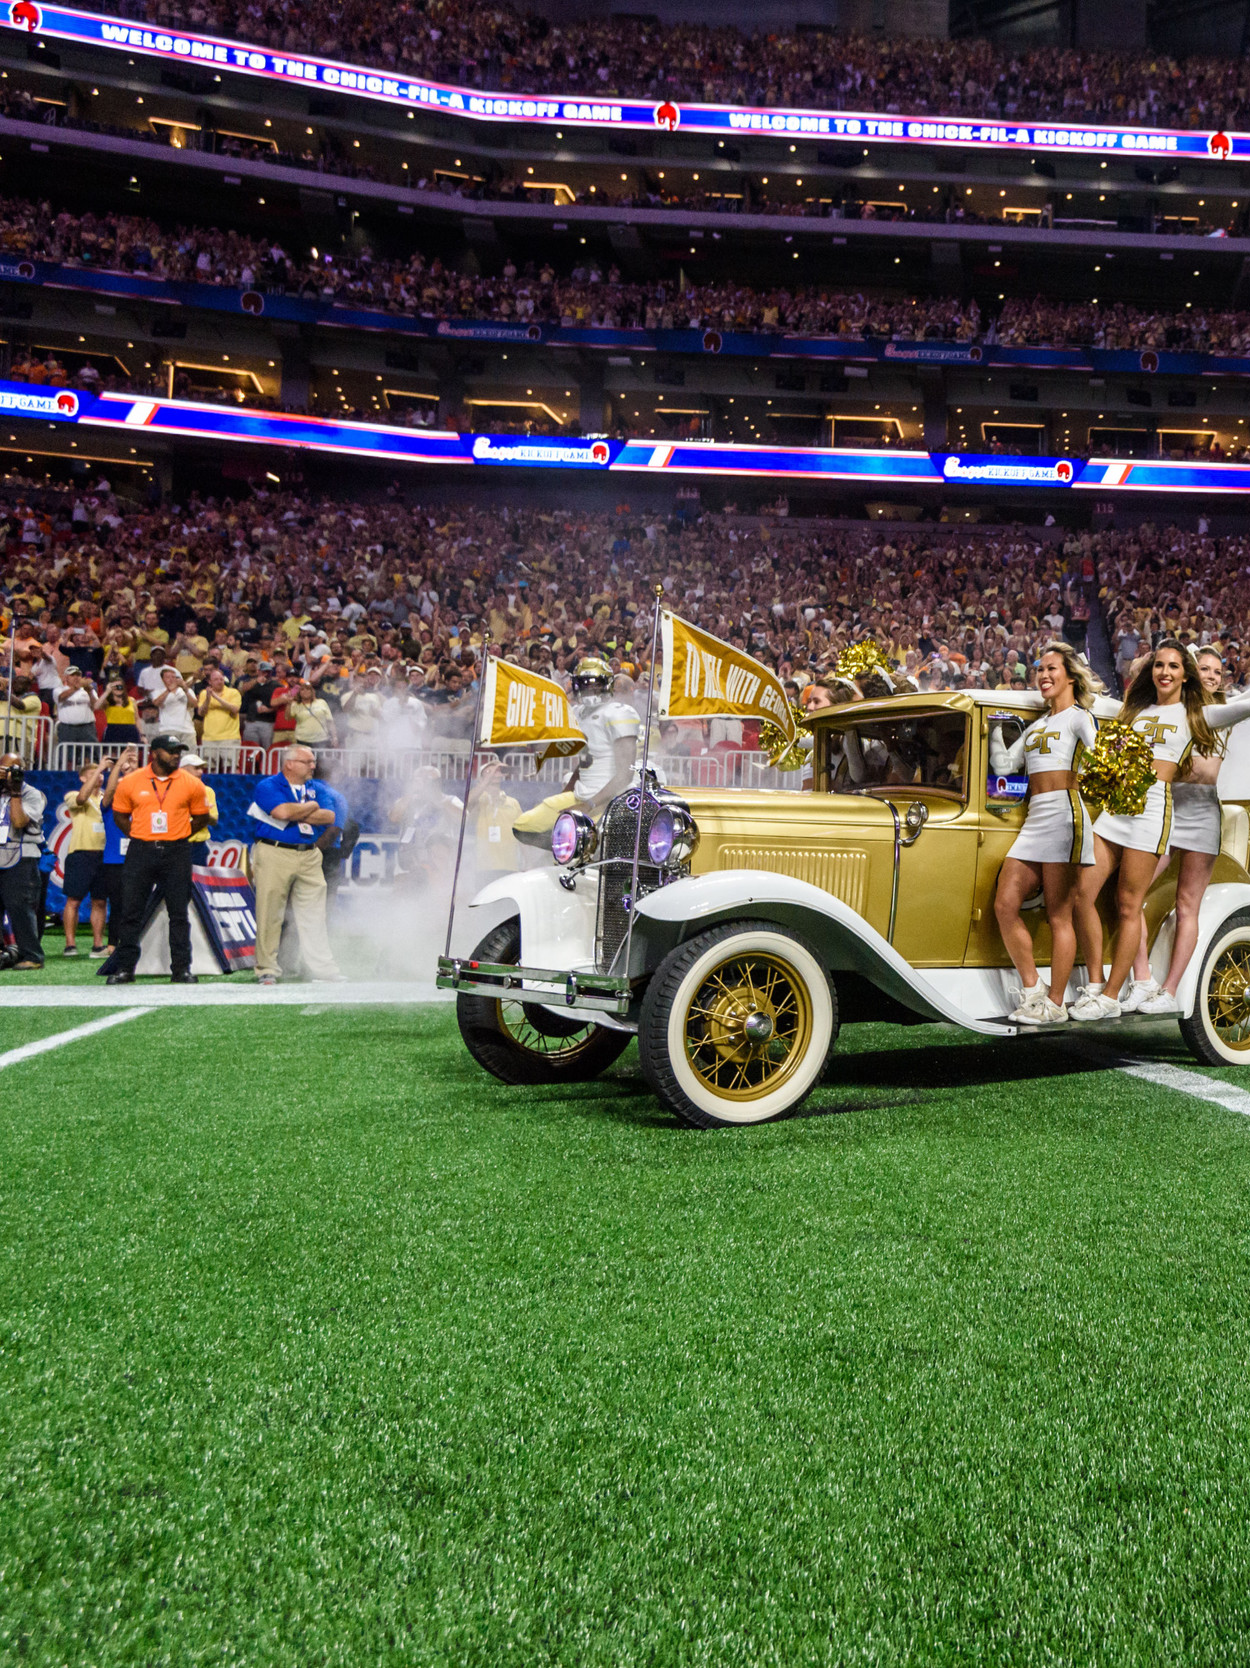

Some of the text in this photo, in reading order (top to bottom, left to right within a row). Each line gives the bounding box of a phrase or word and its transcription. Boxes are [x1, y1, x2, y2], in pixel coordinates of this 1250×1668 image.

[101, 23, 623, 121] WELCOME TO THE CHICK-FIL-A KICKOFF GAME
[729, 113, 1178, 151] WELCOME TO THE CHICK-FIL-A KICKOFF GAME
[20, 399, 55, 410] GAME
[1096, 503, 1114, 513] 115
[684, 641, 701, 699] TO
[726, 664, 761, 705] WITH
[506, 681, 536, 728] GIVE
[1024, 727, 1060, 755] GT
[1130, 715, 1178, 744] GT
